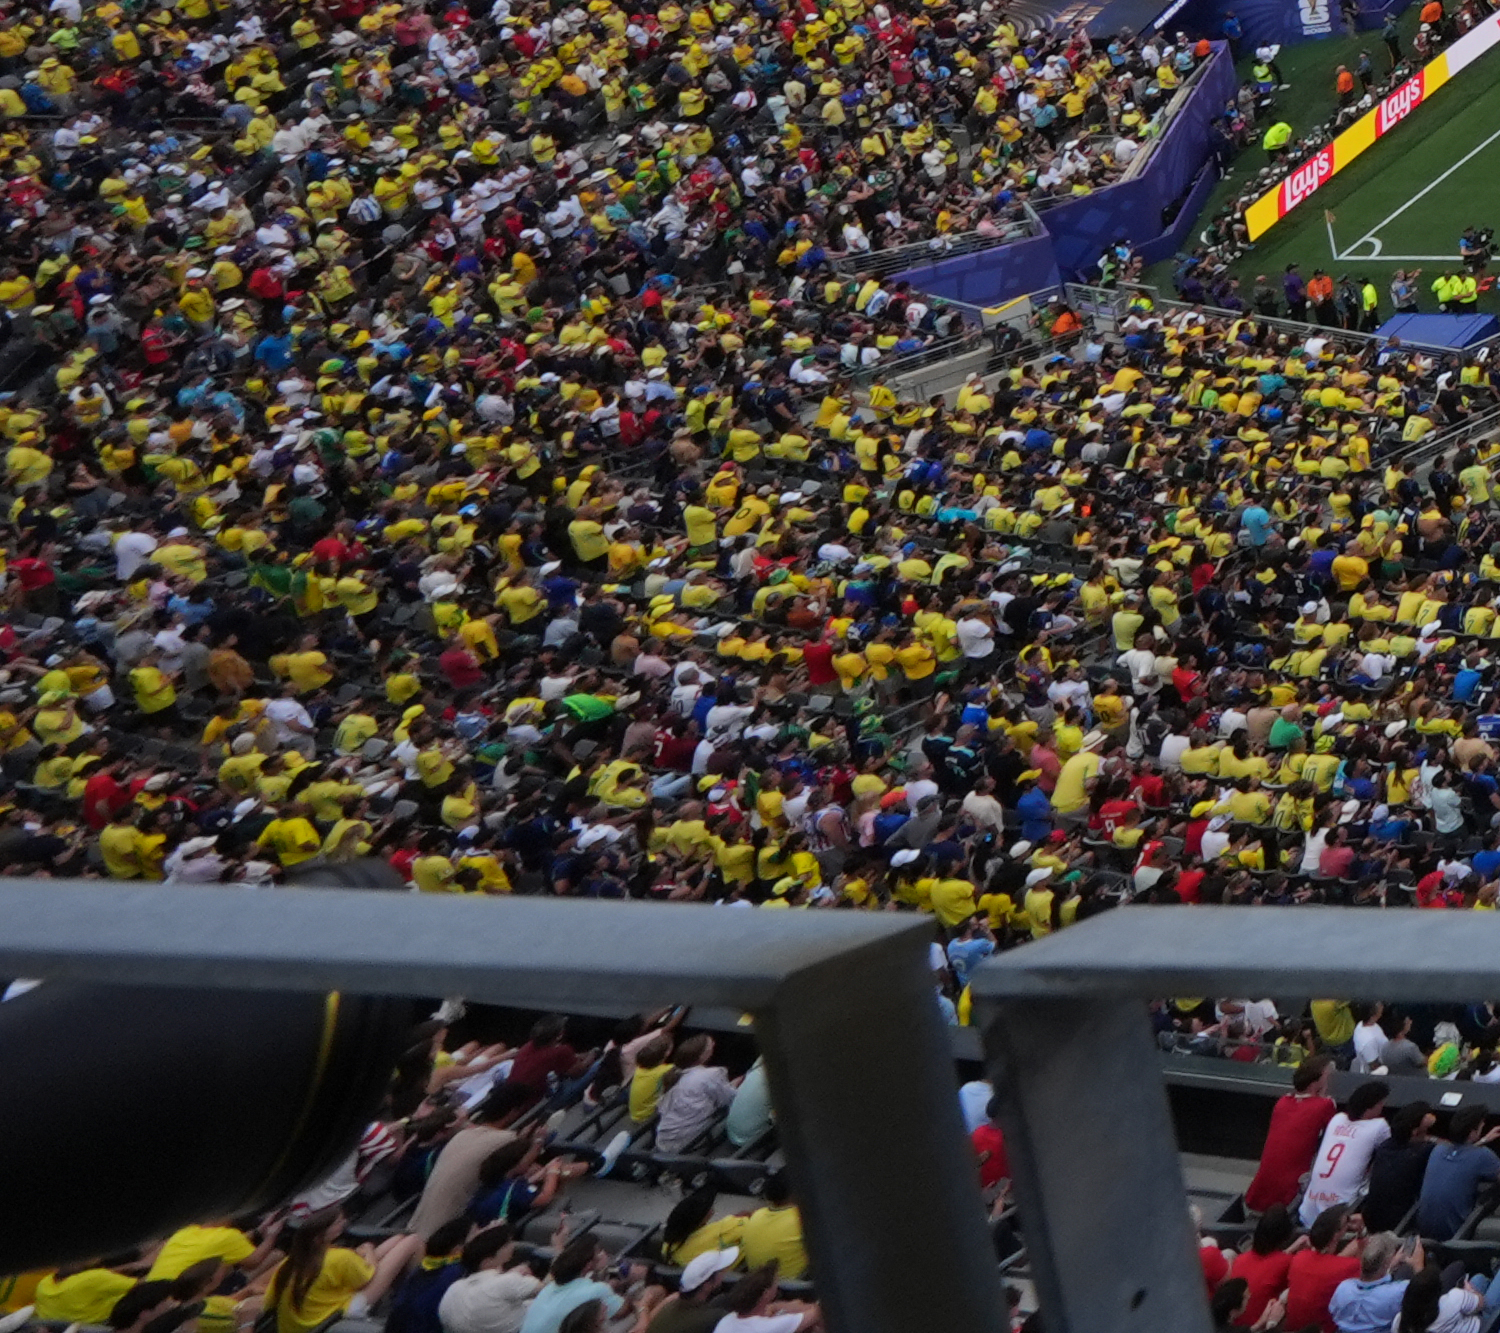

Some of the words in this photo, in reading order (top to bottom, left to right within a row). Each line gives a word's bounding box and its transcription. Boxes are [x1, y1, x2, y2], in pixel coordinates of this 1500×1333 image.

[1381, 77, 1422, 133] Lay's
[1284, 150, 1331, 213] Lay's
[1318, 1142, 1346, 1179] 9
